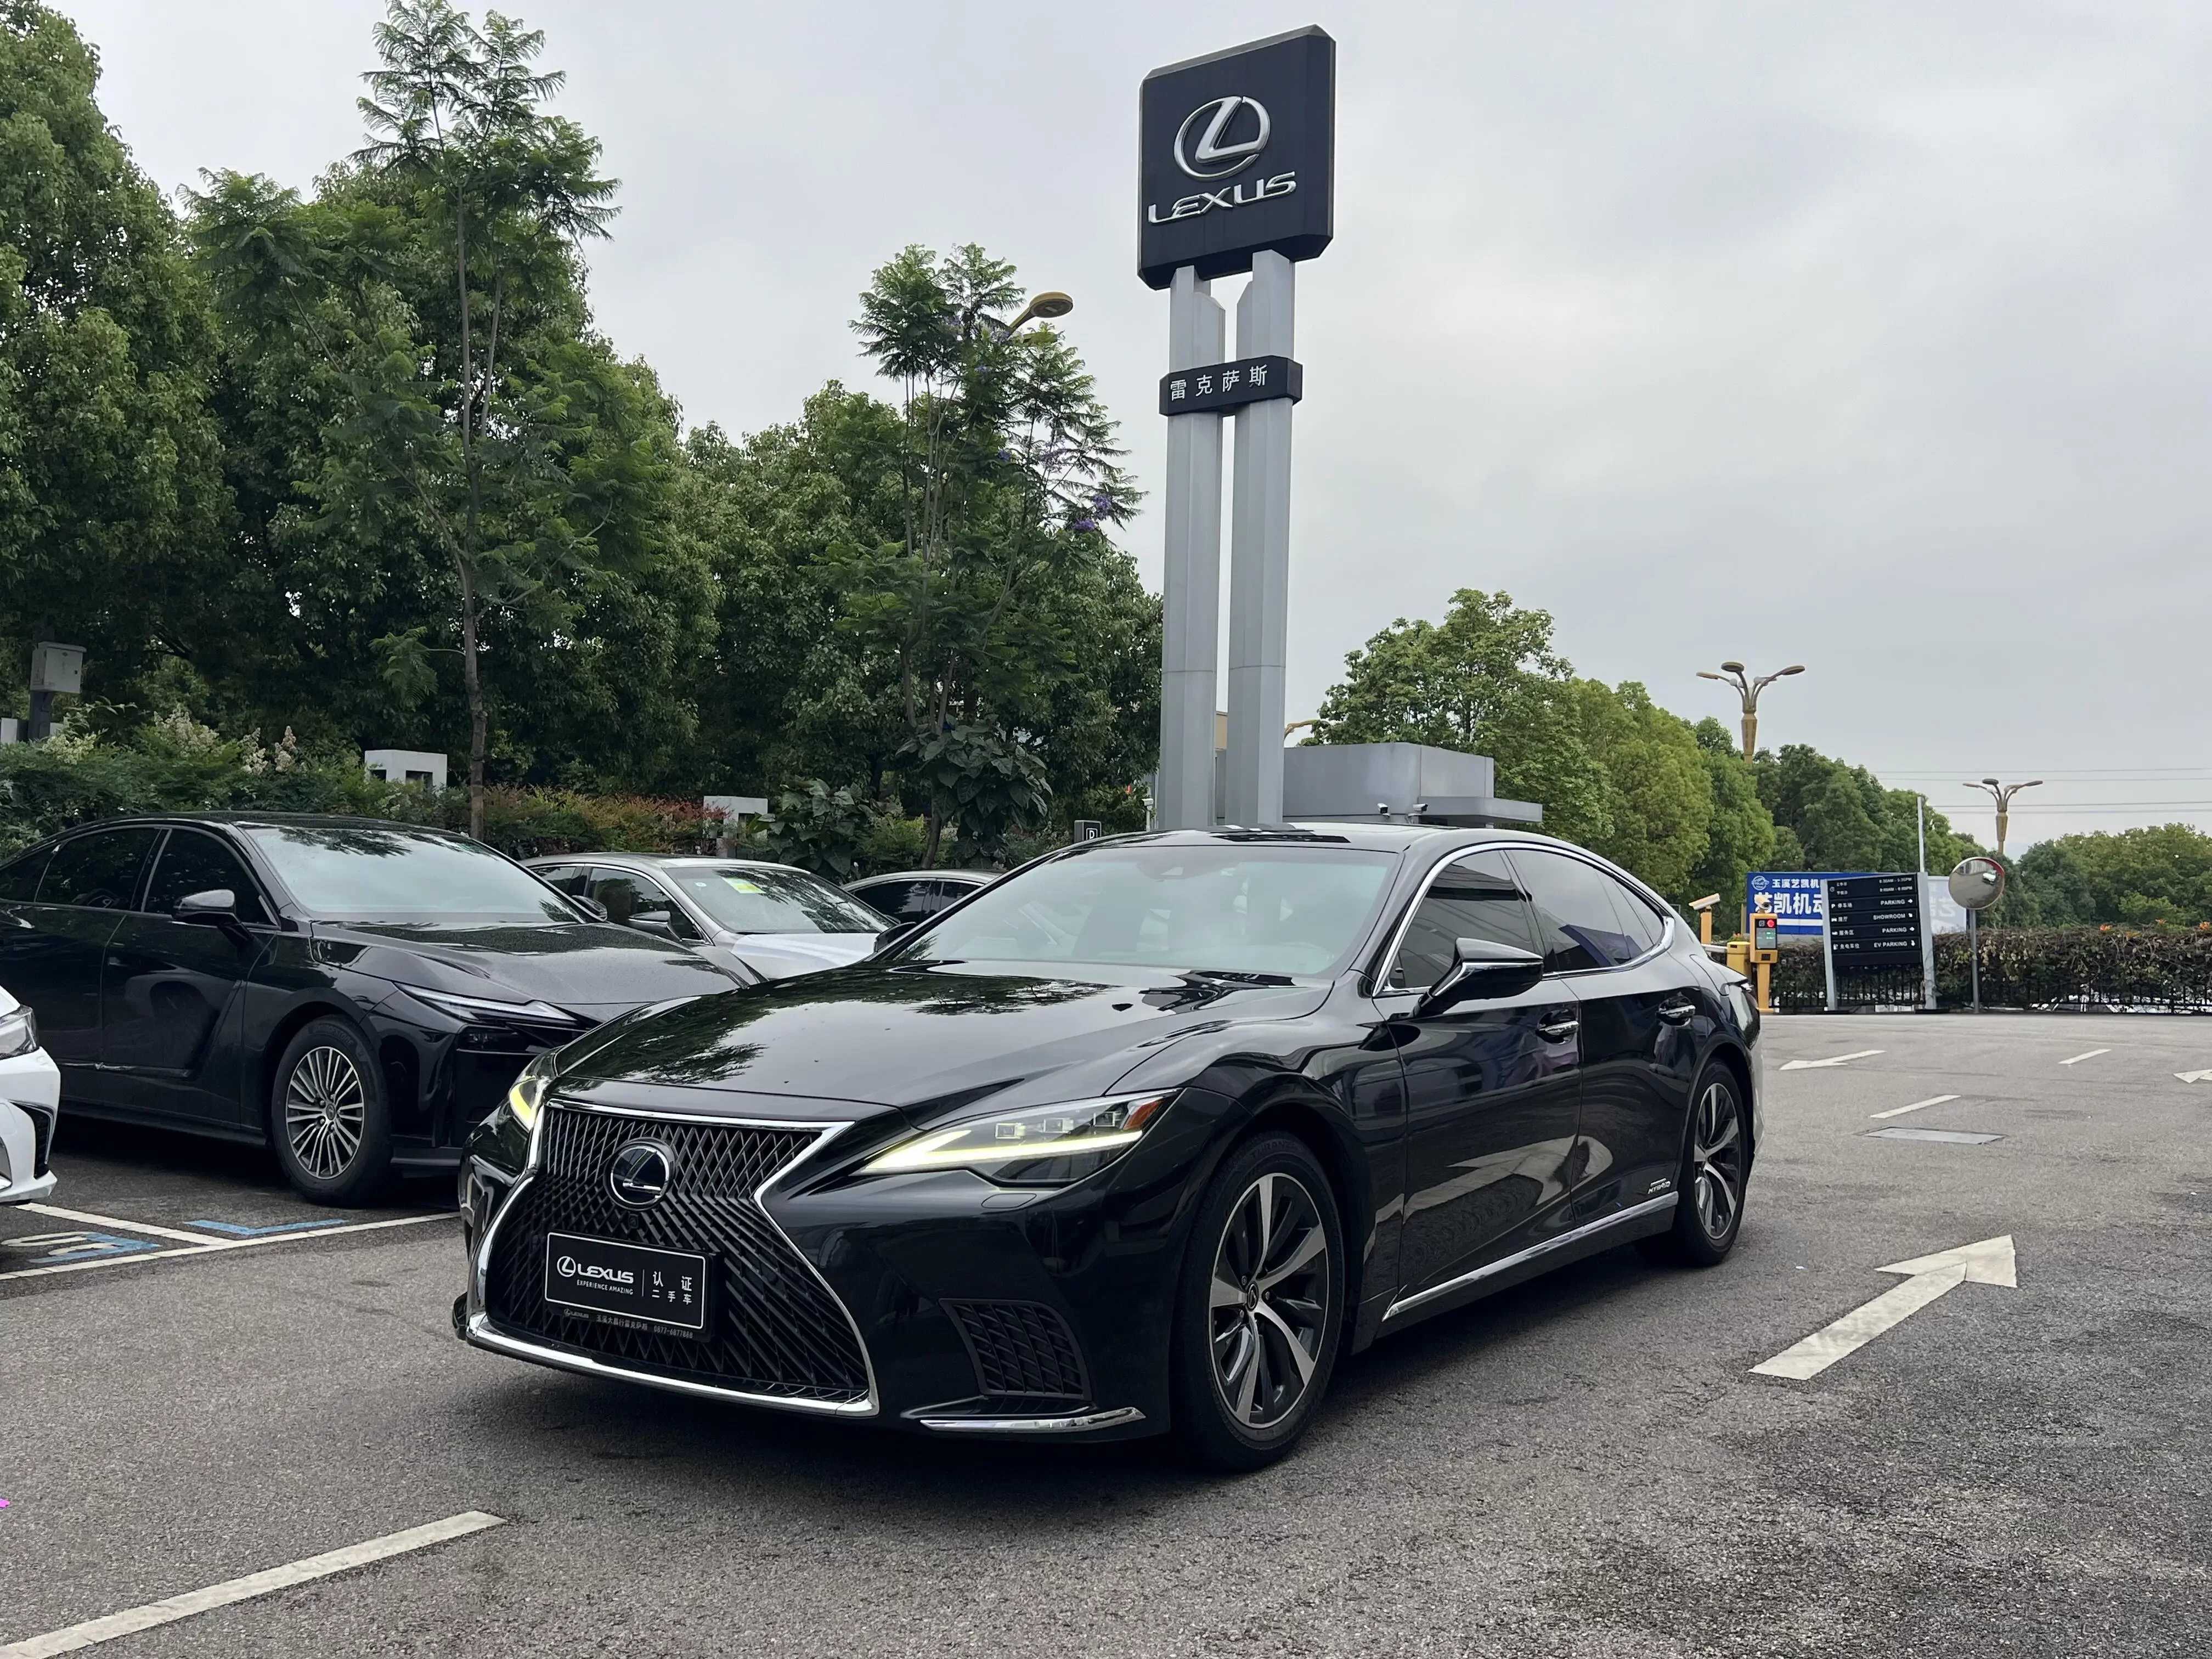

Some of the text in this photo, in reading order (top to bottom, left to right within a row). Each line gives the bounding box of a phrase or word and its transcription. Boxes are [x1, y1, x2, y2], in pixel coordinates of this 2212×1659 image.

[1148, 171, 1297, 223] LEXUS
[1170, 364, 1267, 401] 雷克萨斯
[1647, 1181, 1671, 1194] HYBRID
[578, 1263, 634, 1284] LEXUS
[577, 1279, 634, 1295] EXPERIENCE AMAZING
[652, 1289, 692, 1305] 二手车
